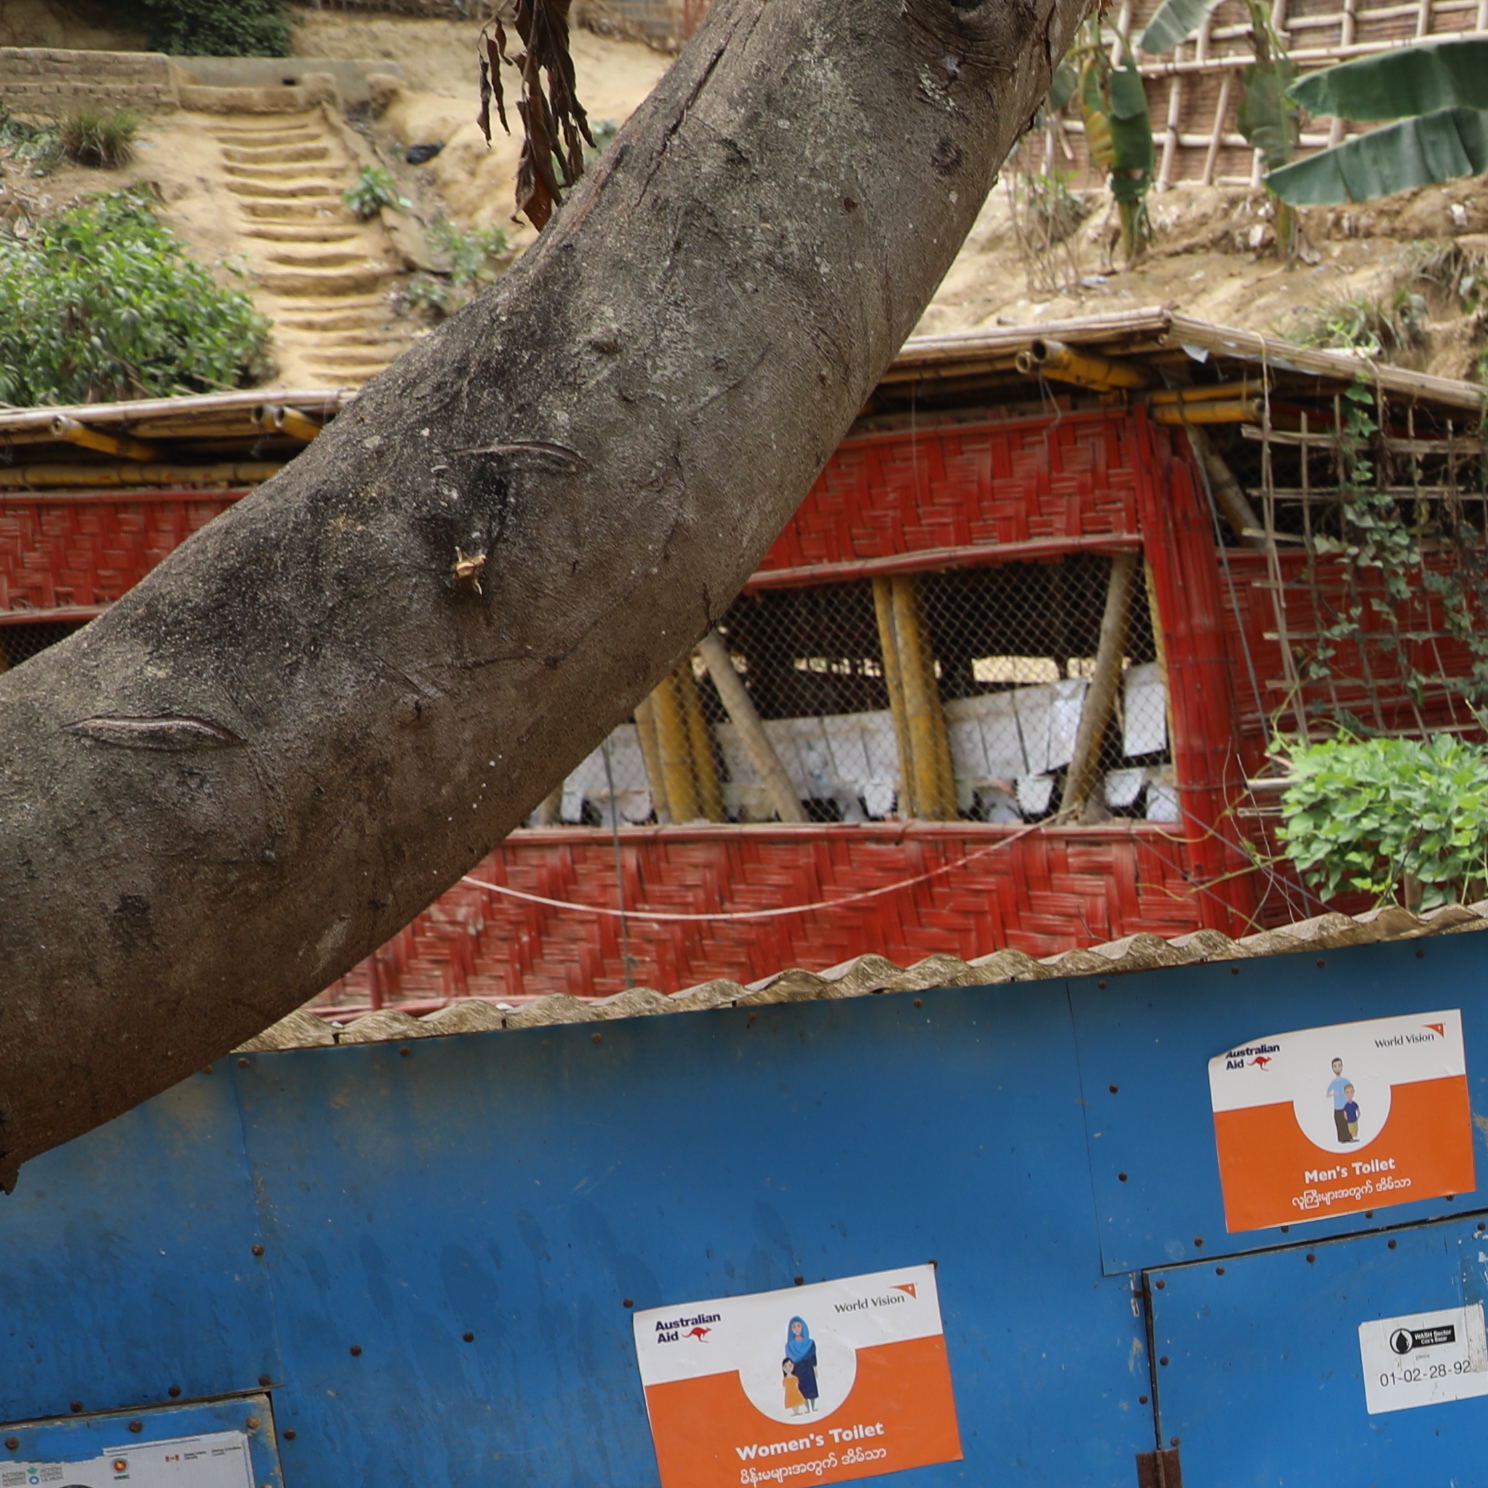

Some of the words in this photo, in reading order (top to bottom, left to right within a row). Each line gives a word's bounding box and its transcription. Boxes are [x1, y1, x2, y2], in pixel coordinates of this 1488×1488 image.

[1374, 1035, 1404, 1049] World
[1405, 1031, 1434, 1045] Vision
[1225, 1043, 1280, 1059] Australian
[1225, 1058, 1245, 1071] Aid
[1304, 1165, 1348, 1184] Men's
[1351, 1157, 1396, 1176] Toilet
[834, 1296, 869, 1314] World
[870, 1293, 906, 1309] Vision
[655, 1312, 721, 1332] Australian
[657, 1330, 679, 1344] Aid
[1380, 1360, 1471, 1388] 01-02-28-92
[735, 1433, 825, 1461] Women's
[828, 1422, 885, 1443] Toilet
[841, 1447, 887, 1465] အိမ်သာ
